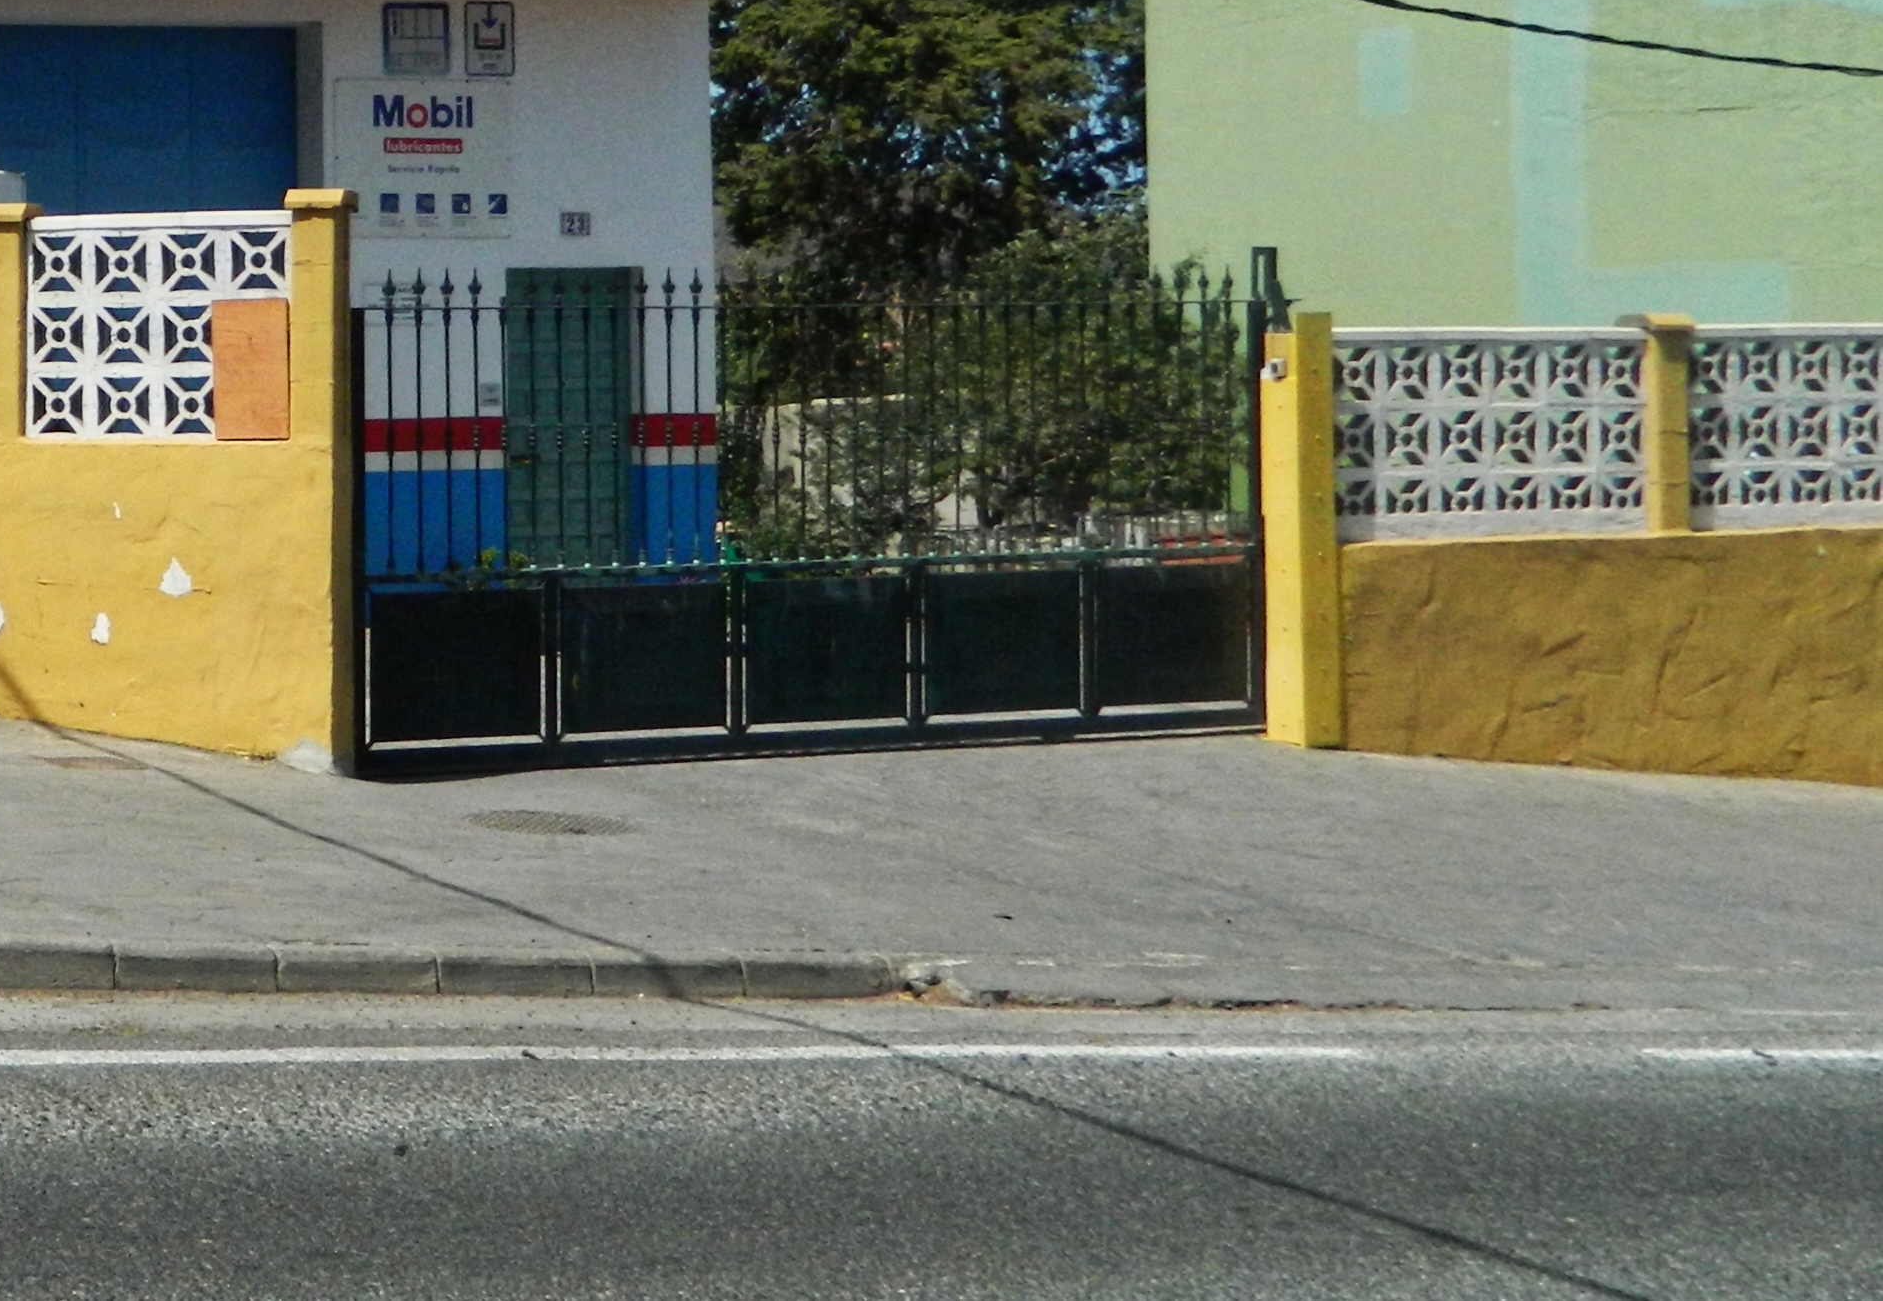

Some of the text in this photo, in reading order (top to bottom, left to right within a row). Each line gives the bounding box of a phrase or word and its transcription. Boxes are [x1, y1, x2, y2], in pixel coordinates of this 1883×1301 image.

[373, 94, 473, 128] Mobil
[386, 139, 461, 153] lubricantes
[566, 215, 586, 233] 23
